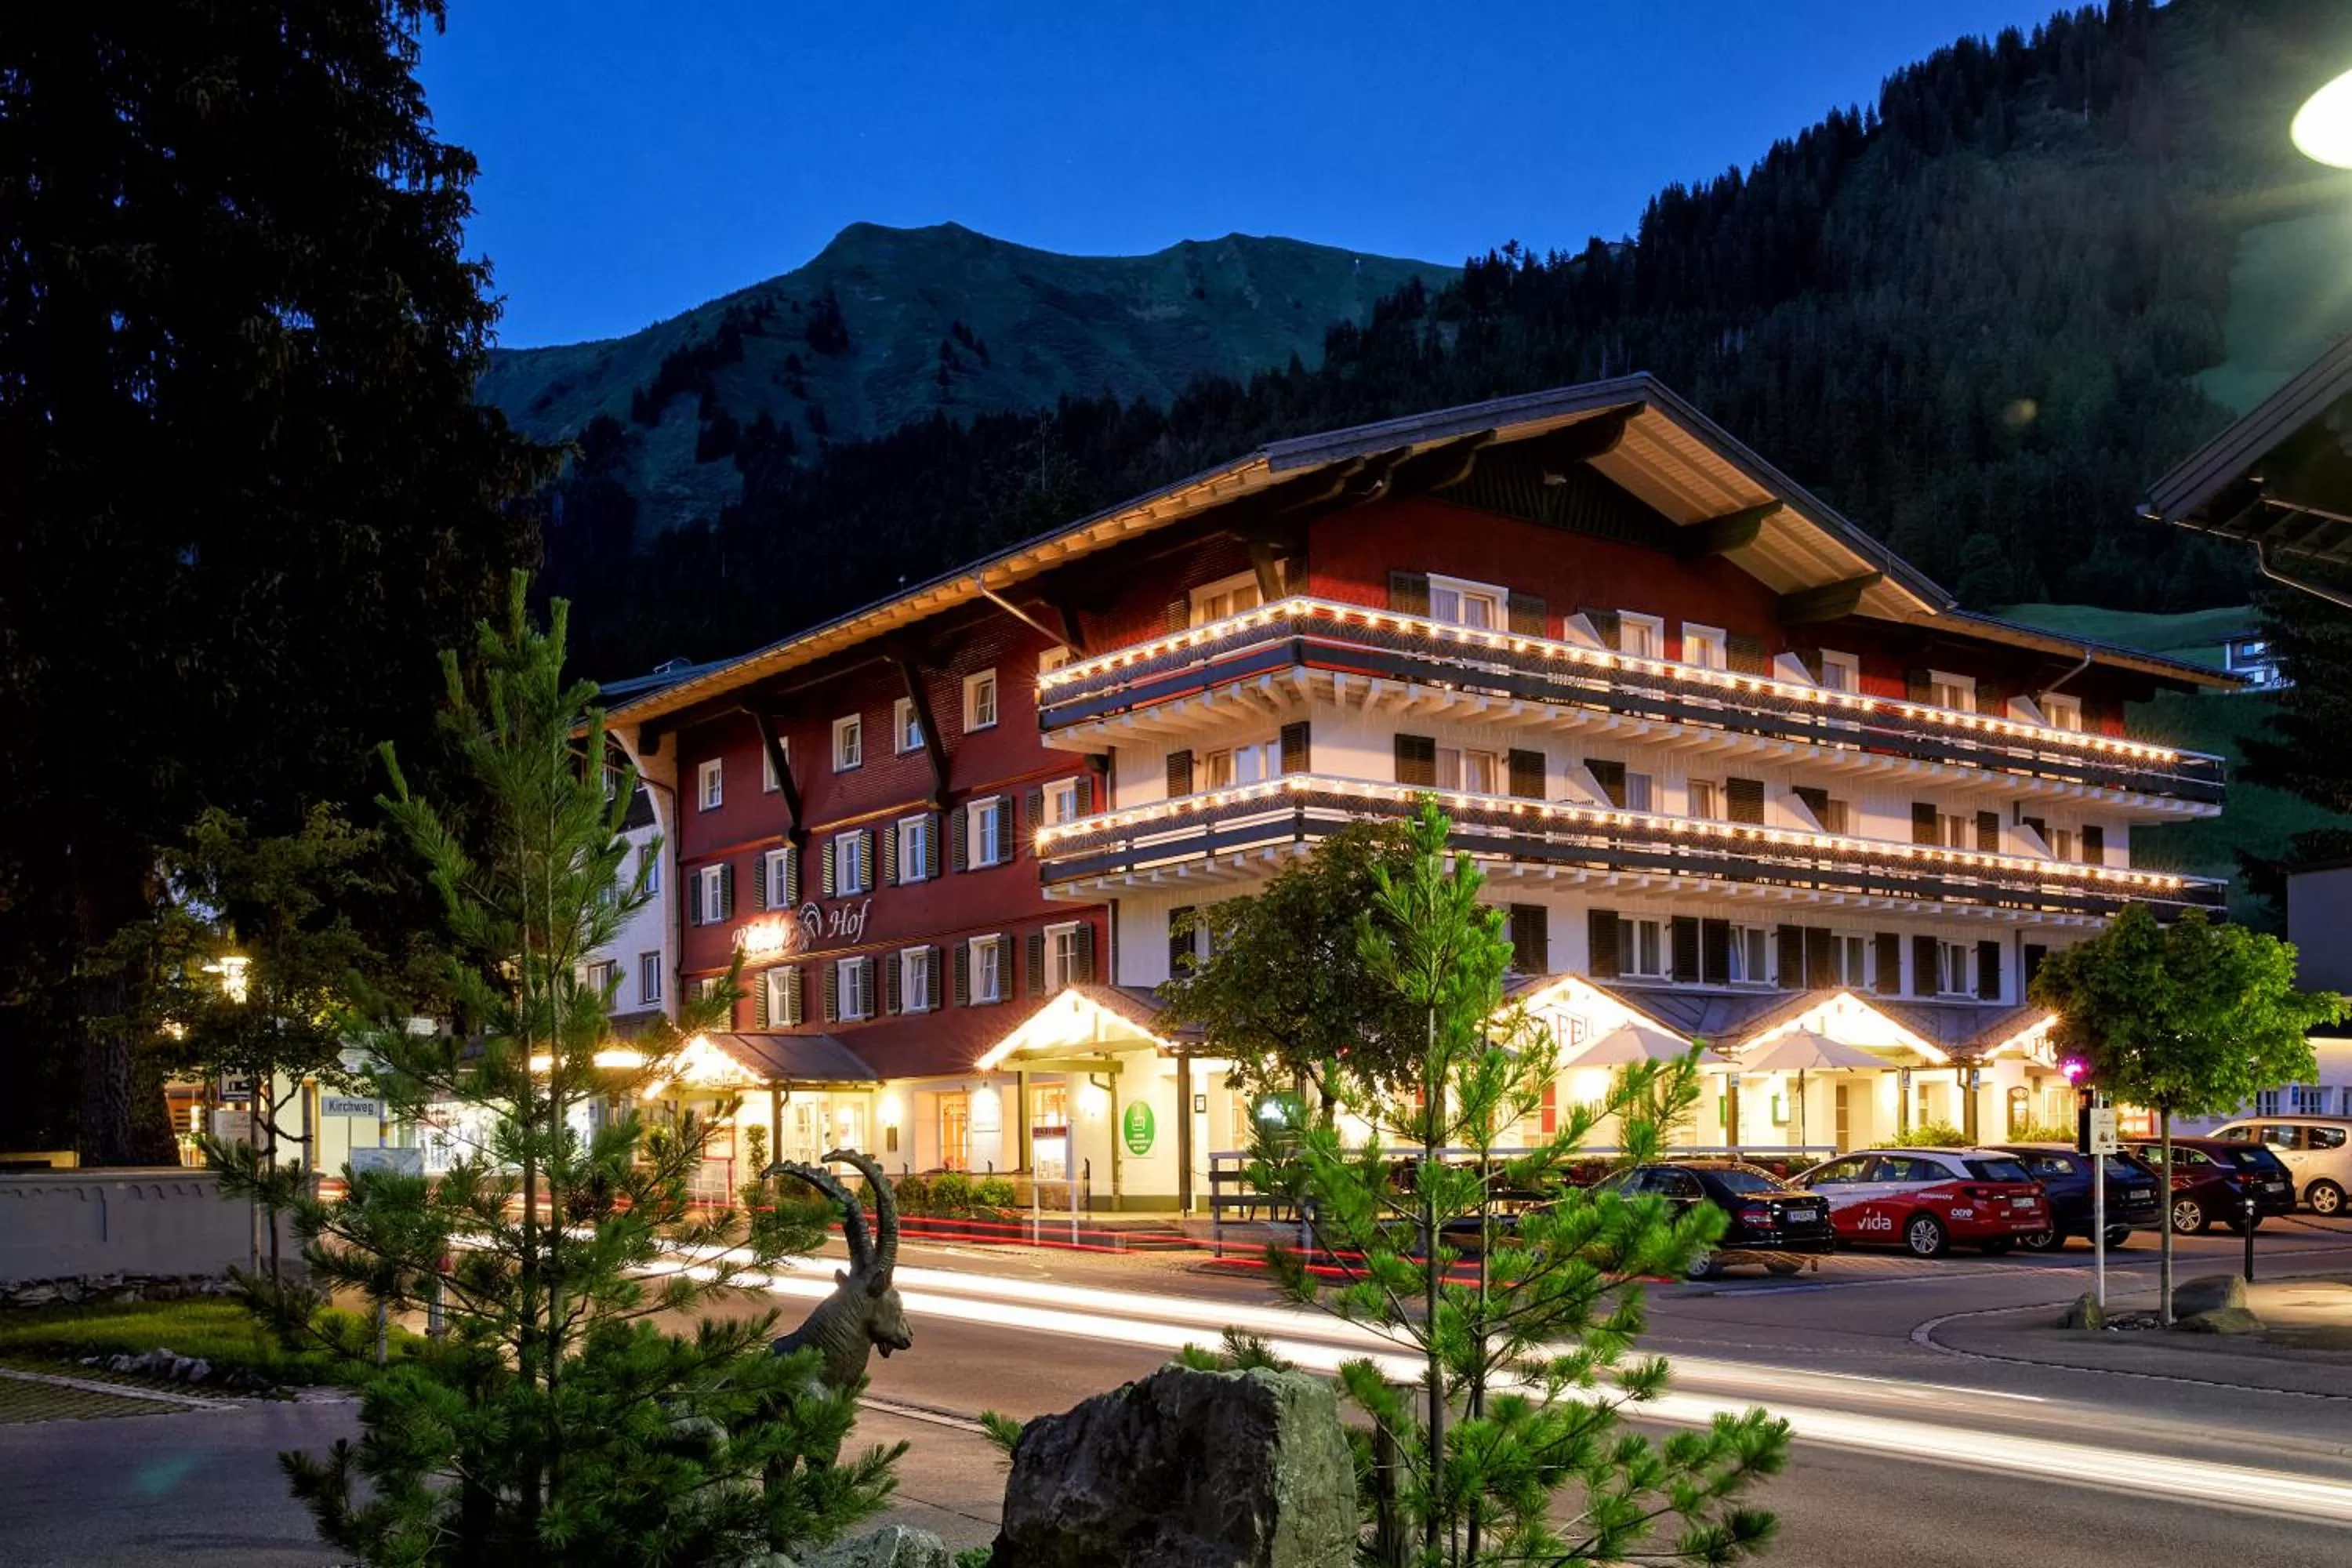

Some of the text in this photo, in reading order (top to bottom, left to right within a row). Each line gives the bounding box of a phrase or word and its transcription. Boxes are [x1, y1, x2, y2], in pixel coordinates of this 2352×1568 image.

[828, 898, 872, 943] Hof
[328, 1099, 374, 1115] Kirchweg
[1857, 1207, 1892, 1230] vida
